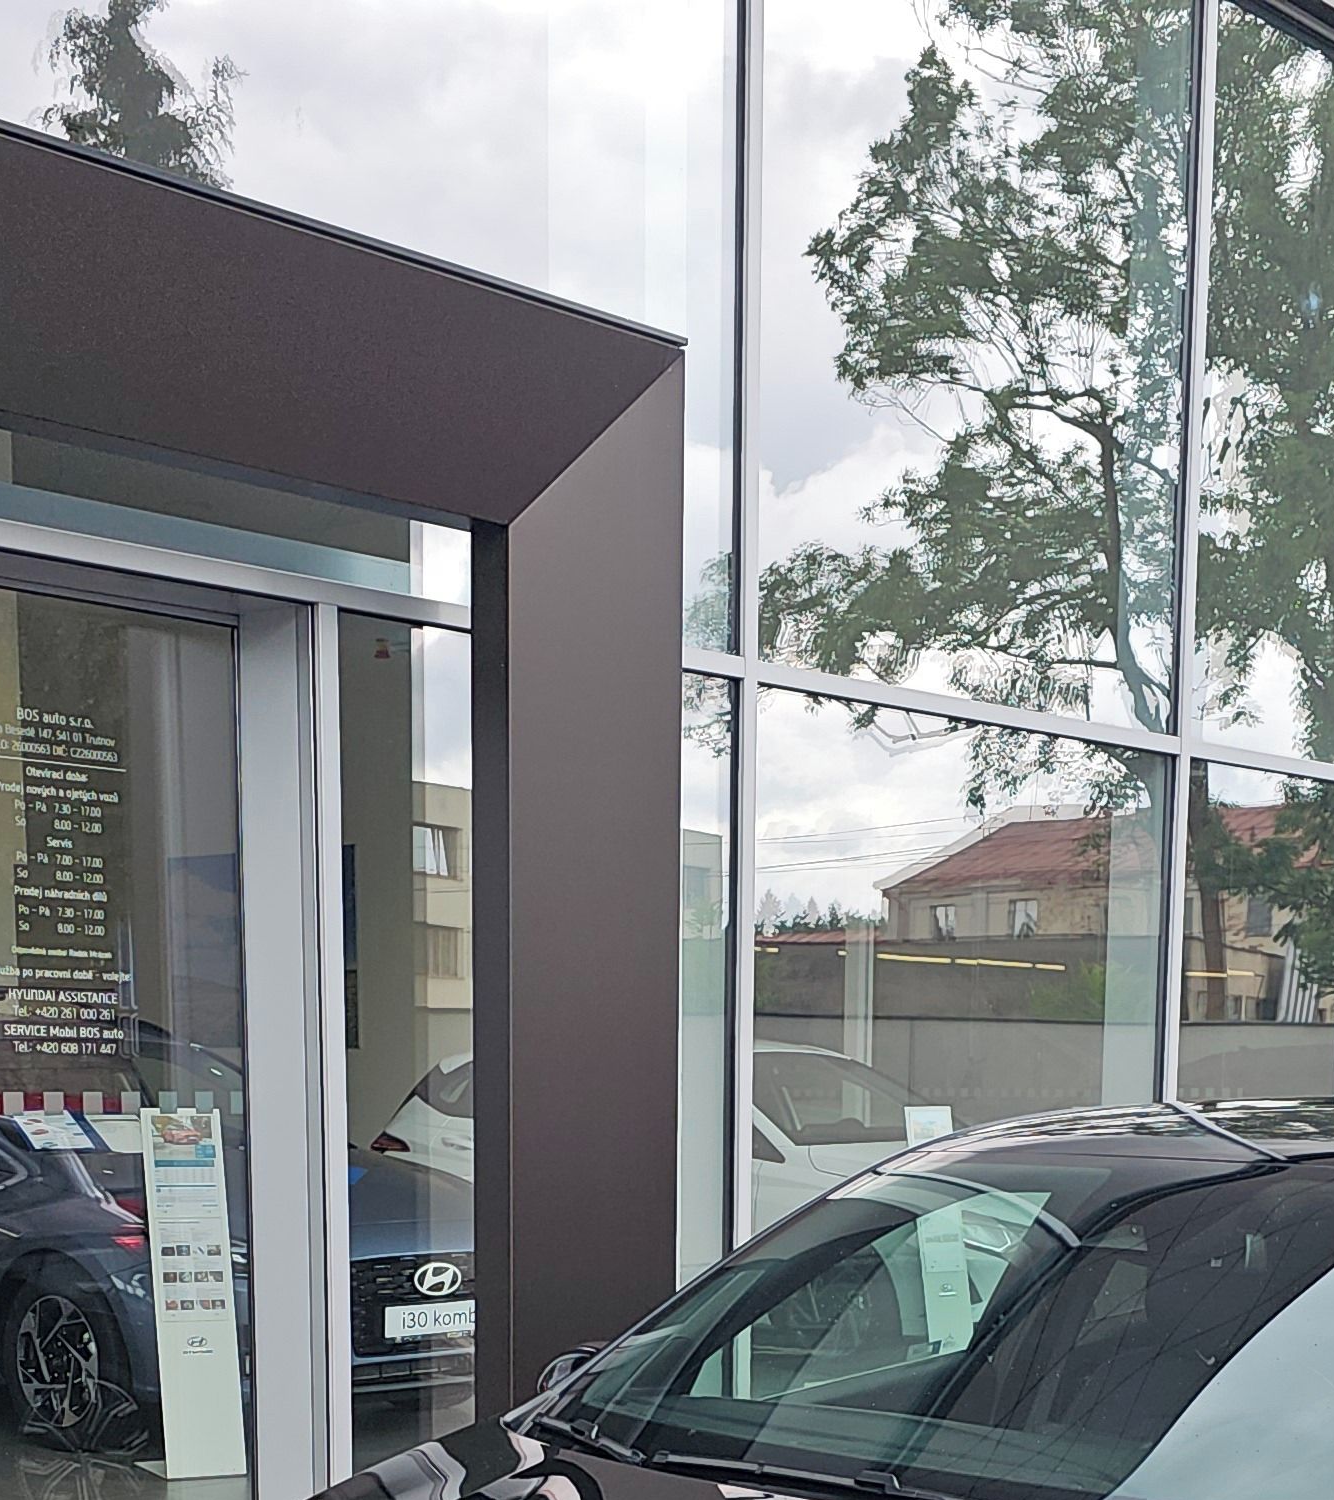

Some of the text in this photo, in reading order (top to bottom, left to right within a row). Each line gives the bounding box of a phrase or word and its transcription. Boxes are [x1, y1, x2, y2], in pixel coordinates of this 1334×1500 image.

[16, 707, 94, 728] BOS auto s.r.o.
[73, 732, 82, 742] 01
[26, 785, 56, 797] nových
[14, 799, 26, 810] Po
[35, 801, 47, 812] Pá
[53, 803, 71, 815] 7.30
[80, 806, 101, 818] 17.00
[14, 816, 26, 826] So
[53, 819, 71, 831] 8.00
[81, 822, 102, 833] 12.00
[46, 836, 73, 848] Servis
[16, 851, 28, 863] Po
[37, 852, 49, 864] Pá
[55, 854, 73, 865] 7.00
[82, 856, 103, 868] 17.00
[17, 867, 28, 878] So
[55, 870, 73, 882] 8.00
[82, 872, 104, 884] 12.00
[14, 885, 43, 899] Prodej
[17, 904, 29, 915] Po
[38, 905, 51, 917] Pá
[57, 907, 75, 918] 7.30
[83, 909, 104, 920] 17.00
[18, 920, 30, 931] So
[57, 923, 75, 934] 8.00
[84, 925, 105, 936] 12.00
[22, 968, 33, 978] po
[35, 969, 71, 979] pracovní
[8, 988, 118, 1004] HYUNDAI ASSISTANCE
[35, 1006, 58, 1018] +420
[61, 1007, 76, 1019] 261
[80, 1009, 97, 1020] 000
[99, 1009, 115, 1020] 261
[4, 1024, 124, 1039] SERVICE Mobil BOS auto
[35, 1042, 58, 1053] +420
[61, 1042, 78, 1054] 608
[82, 1043, 96, 1054] 171
[99, 1043, 116, 1055] 447
[402, 1311, 427, 1329] i30
